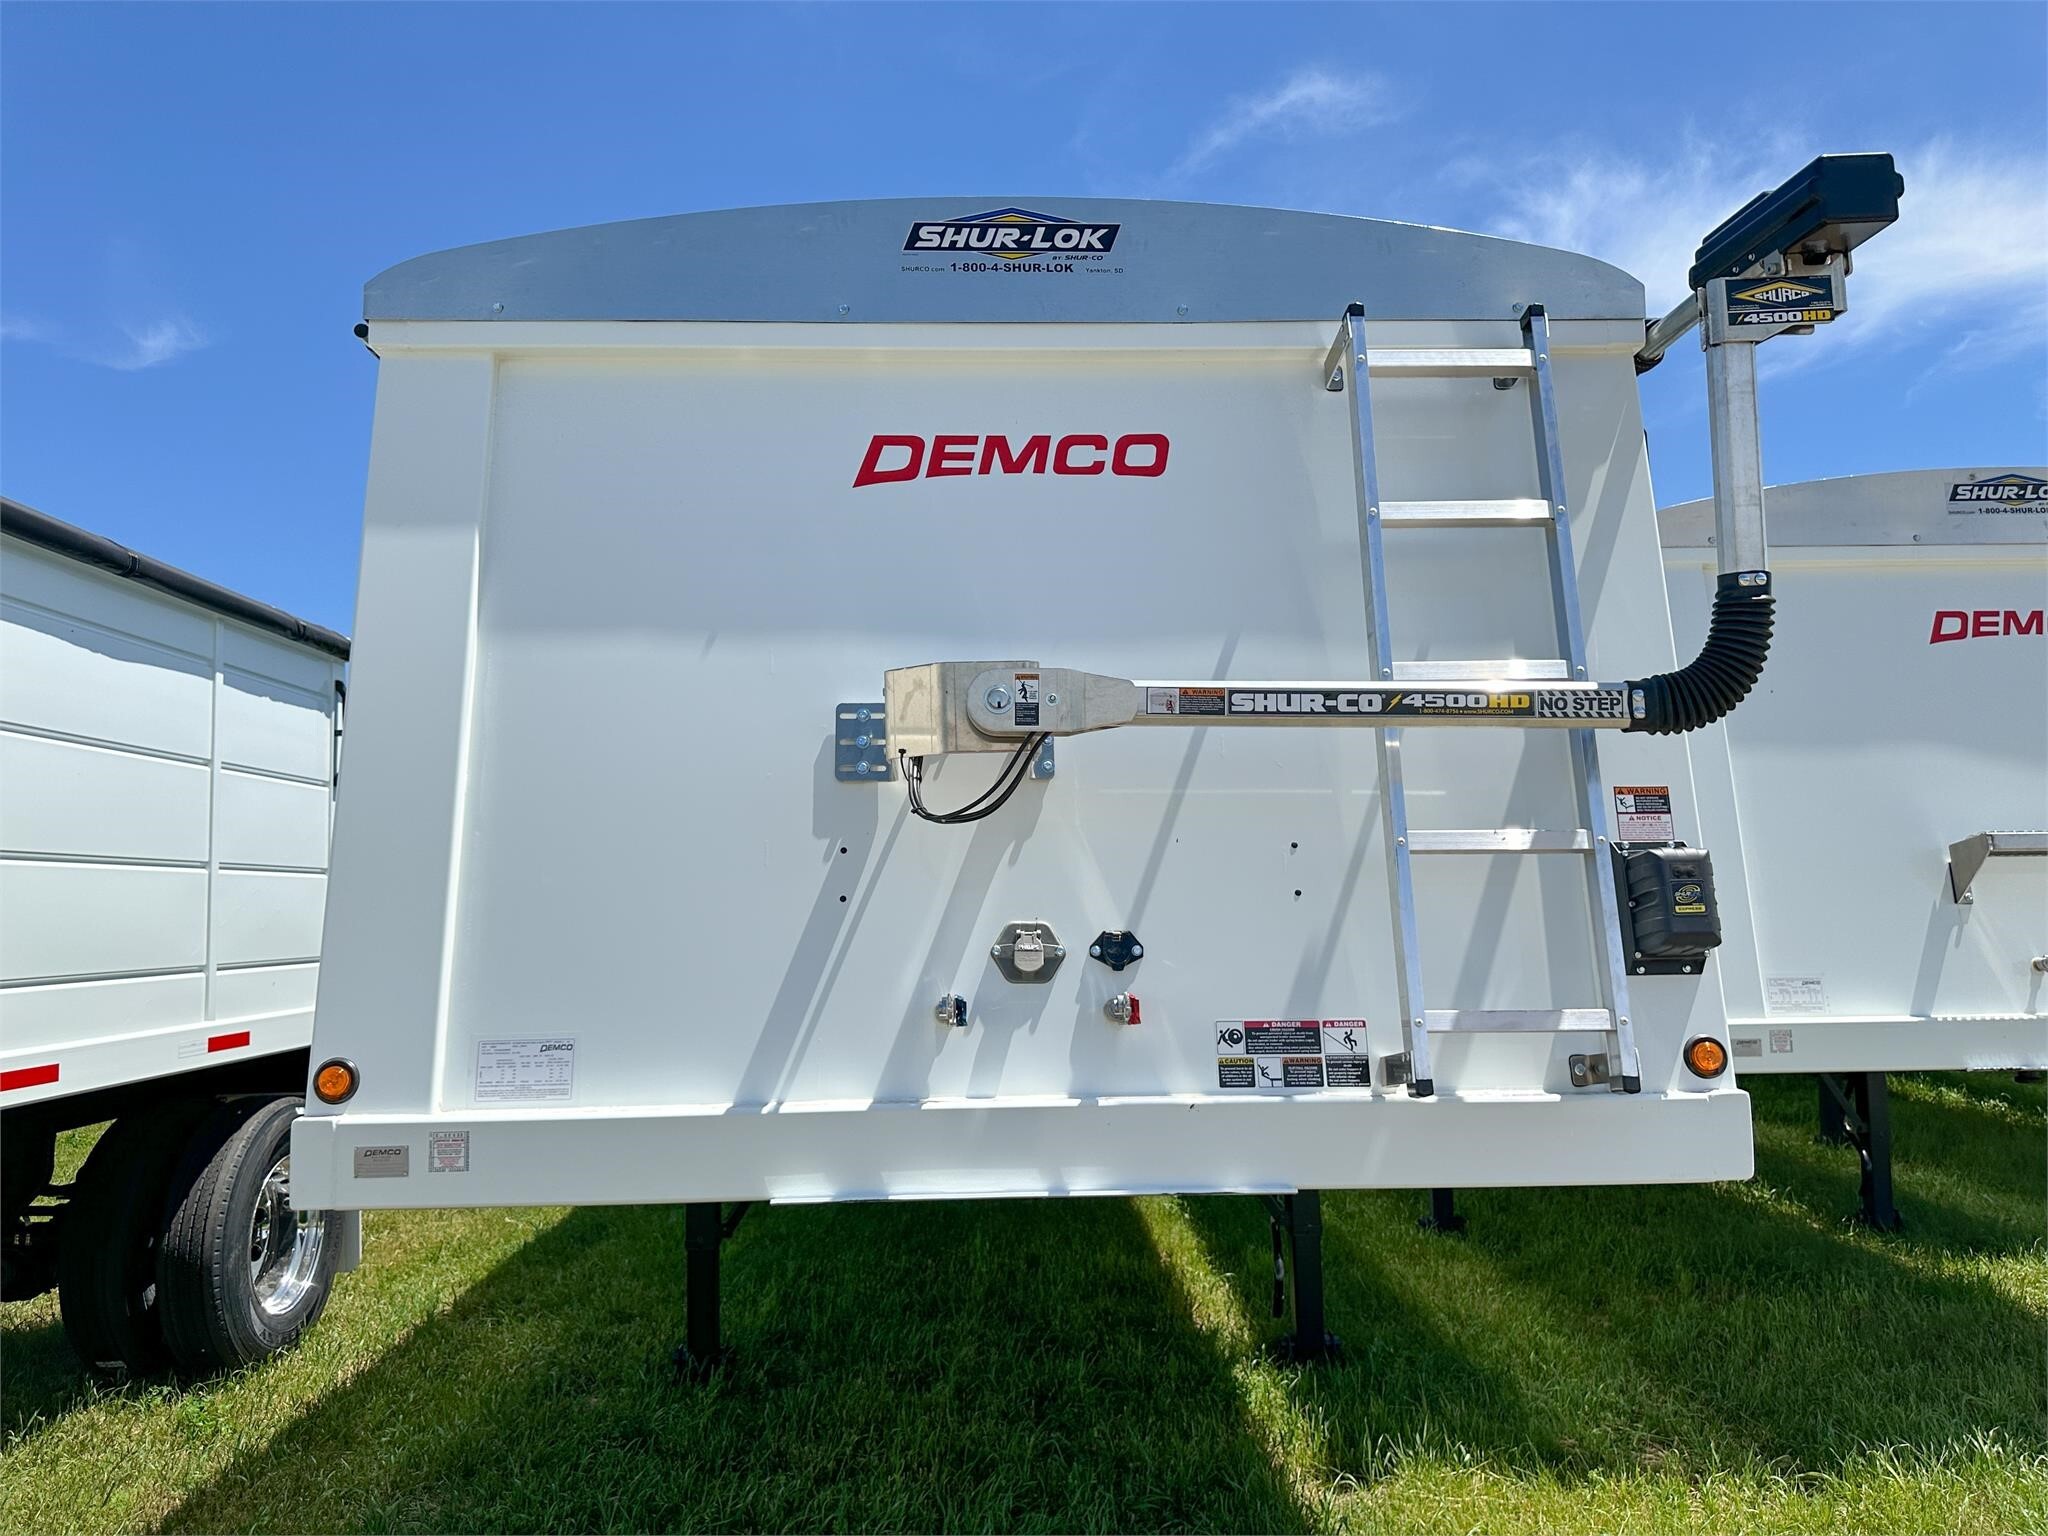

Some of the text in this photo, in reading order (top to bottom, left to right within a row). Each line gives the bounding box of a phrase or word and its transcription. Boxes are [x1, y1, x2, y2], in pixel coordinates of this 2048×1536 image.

[914, 225, 1109, 249] SHUR-LOK
[950, 262, 1074, 273] 1-800-4-SHUR-LOK
[1754, 288, 1811, 302] SHURCO
[852, 433, 1170, 488] DEMCO
[1930, 610, 2048, 644] DEM
[1231, 692, 1383, 713] SHUR-CO
[1540, 696, 1621, 712] NO STEP
[1626, 787, 1666, 795] WARNING
[540, 1043, 573, 1052] DEMCO
[364, 1148, 401, 1157] DEMCO
